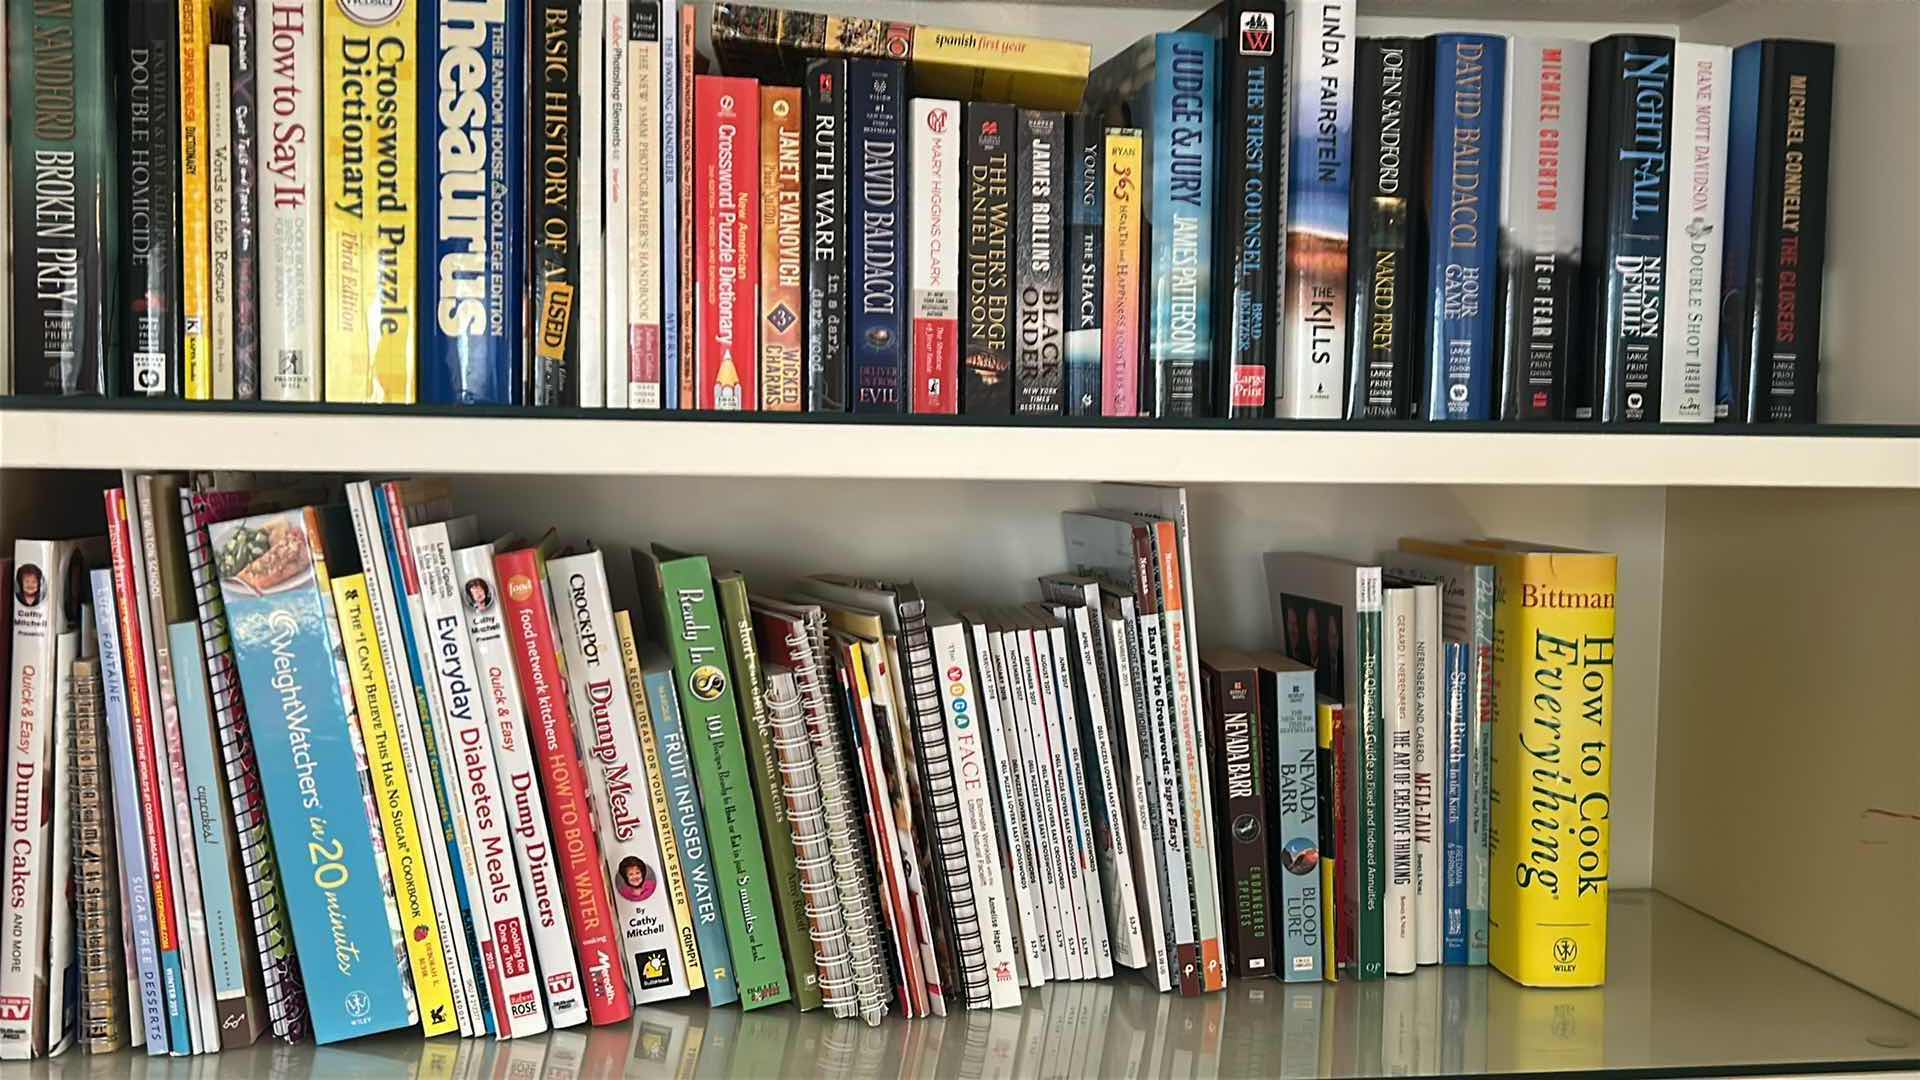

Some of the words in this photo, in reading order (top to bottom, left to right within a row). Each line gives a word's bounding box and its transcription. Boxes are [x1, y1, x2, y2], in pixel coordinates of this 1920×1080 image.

[272, 3, 304, 80] How
[545, 8, 568, 82] BASIC
[1321, 5, 1346, 68] LINDA
[33, 25, 76, 139] SANDFORD
[131, 49, 150, 140] DOUBLE
[1247, 66, 1265, 106] THE
[1379, 48, 1404, 95] JOHN
[1696, 62, 1713, 101] DIANE
[273, 86, 302, 115] to
[335, 35, 371, 218] Dictionary
[376, 37, 407, 211] Crossword
[1694, 105, 1711, 142] MOTT
[1787, 75, 1807, 146] MICHAEL
[267, 122, 305, 174] Say
[545, 92, 568, 209] HISTORY
[778, 126, 799, 180] JANET
[816, 114, 833, 179] RUTH
[930, 137, 942, 176] MARY
[1245, 114, 1264, 172] FIRST
[1316, 76, 1342, 182] FAIRSTEIN
[1377, 99, 1402, 193] SANDFORD
[35, 150, 76, 237] BROKEN
[214, 145, 227, 192] Words
[717, 125, 735, 207] Crossword
[863, 140, 894, 205] DAVID
[990, 153, 1007, 196] THE
[1032, 139, 1051, 197] JAMES
[1083, 144, 1098, 205] YOUNG
[1692, 145, 1711, 214] DAVIDSON
[1782, 151, 1803, 233] CONNELLY
[132, 149, 150, 265] HOMICIDE
[214, 199, 227, 213] to
[274, 183, 305, 209] It
[738, 191, 748, 219] New
[929, 179, 942, 235] HIGGINS
[971, 164, 988, 245] DANIEL
[214, 220, 228, 243] the
[545, 217, 567, 253] OF
[718, 212, 736, 261] Puzzle
[738, 223, 748, 280] American
[779, 191, 799, 287] EVANOVICH
[816, 192, 834, 261] WARE
[988, 201, 1009, 287] WATER'S
[1032, 202, 1052, 273] ROLLINS
[1083, 233, 1094, 259] THE
[1242, 178, 1263, 276] COUNSEL
[1780, 236, 1799, 266] THE
[36, 247, 78, 304] PREY
[215, 250, 228, 303] Rescue
[378, 225, 408, 334] Puzzle
[827, 274, 838, 293] in
[863, 209, 894, 314] BALDACCI
[930, 239, 942, 287] CLARK
[1375, 251, 1396, 309] NAKED
[1688, 242, 1707, 308] DOUBLE
[716, 266, 736, 344] Dictionary
[811, 288, 824, 328] dark
[827, 300, 837, 309] a
[969, 252, 987, 339] JUDSON
[1080, 262, 1096, 327] SHACK
[1311, 286, 1336, 297] THE
[1615, 256, 1644, 337] DEMILLE
[1639, 256, 1661, 337] NELSON
[1776, 271, 1797, 343] CLOSERS
[544, 291, 571, 349] USED
[826, 315, 840, 359] dark,
[989, 295, 1008, 350] EDGE
[1021, 286, 1040, 380] ORDER
[1042, 290, 1060, 378] BLACK
[1238, 290, 1252, 351] MELTZER
[1251, 302, 1263, 339] BRAD
[1304, 301, 1334, 364] KILLS
[1372, 313, 1393, 352] PREY
[1686, 314, 1702, 357] SHOT
[764, 344, 781, 406] CHARMS
[782, 349, 799, 404] WICKED
[812, 334, 823, 372] wood
[519, 608, 537, 639] food
[1521, 584, 1615, 608] Bittman
[525, 641, 548, 694] network
[981, 650, 992, 683] FEBRUARY
[1147, 626, 1159, 657] Easy
[1152, 659, 1161, 673] as
[20, 665, 36, 704] Quick
[487, 666, 507, 705] Quick
[987, 684, 995, 700] 2018
[1153, 675, 1165, 696] Pie
[1416, 641, 1426, 699] NIERENBERG
[1583, 634, 1614, 724] How
[18, 720, 33, 755] Easy
[21, 708, 34, 717] &
[270, 631, 320, 809] WeightWatchers
[498, 708, 510, 717] &
[499, 721, 516, 752] Easy
[539, 696, 560, 751] kitchens
[1154, 699, 1172, 776] Crosswords:
[1223, 713, 1249, 761] NEVADA
[1416, 701, 1425, 724] AND
[436, 615, 472, 720] Everyday
[460, 728, 496, 830] Diabetes
[482, 836, 513, 904] Meals
[586, 679, 616, 761] Dump
[601, 762, 639, 843] Meals
[622, 636, 633, 663] 100+
[629, 668, 642, 708] RECIPE
[638, 711, 650, 744] IDEAS
[644, 748, 656, 772] FOR
[650, 774, 665, 805] YOUR
[659, 808, 676, 860] TORTILLA
[670, 864, 685, 905] SEALER
[664, 733, 687, 779] FRUIT
[1000, 760, 1009, 780] DELL
[1416, 726, 1425, 762] CALERO
[1517, 629, 1579, 894] Everything
[1581, 742, 1606, 777] to
[10, 761, 34, 832] Dump
[549, 754, 569, 798] HOW
[1003, 782, 1014, 807] PUZZLE
[1163, 778, 1176, 816] Super
[1229, 763, 1253, 798] BARR
[1281, 763, 1296, 816] BARR
[1300, 748, 1316, 824] NEVADA
[196, 785, 218, 844] cupcakes!
[309, 816, 328, 841] in
[510, 772, 534, 838] Dump
[558, 802, 577, 825] TO
[675, 785, 702, 861] INFUSED
[1006, 809, 1018, 831] LOVERS
[1415, 773, 1431, 843] META-TALK
[565, 828, 584, 868] BOIL
[1011, 832, 1020, 848] EASY
[1166, 817, 1181, 852] Easy!
[1578, 792, 1610, 897] Cook
[11, 839, 32, 909] Cakes
[309, 838, 350, 889] 20
[525, 842, 557, 928] Dinners
[1014, 850, 1028, 889] CROSSWORDS
[131, 877, 150, 922] SUGAR
[574, 871, 599, 929] WATER
[629, 917, 658, 927] Cathy
[691, 867, 716, 925] WATER
[1287, 897, 1303, 937] LURE
[1302, 888, 1318, 946] BLOOD
[13, 912, 23, 937] AND
[140, 930, 152, 964] FREE
[323, 891, 361, 977] minutes
[627, 930, 664, 940] Mitchell
[11, 940, 22, 973] MORE
[144, 971, 161, 1041] DESSERTS
